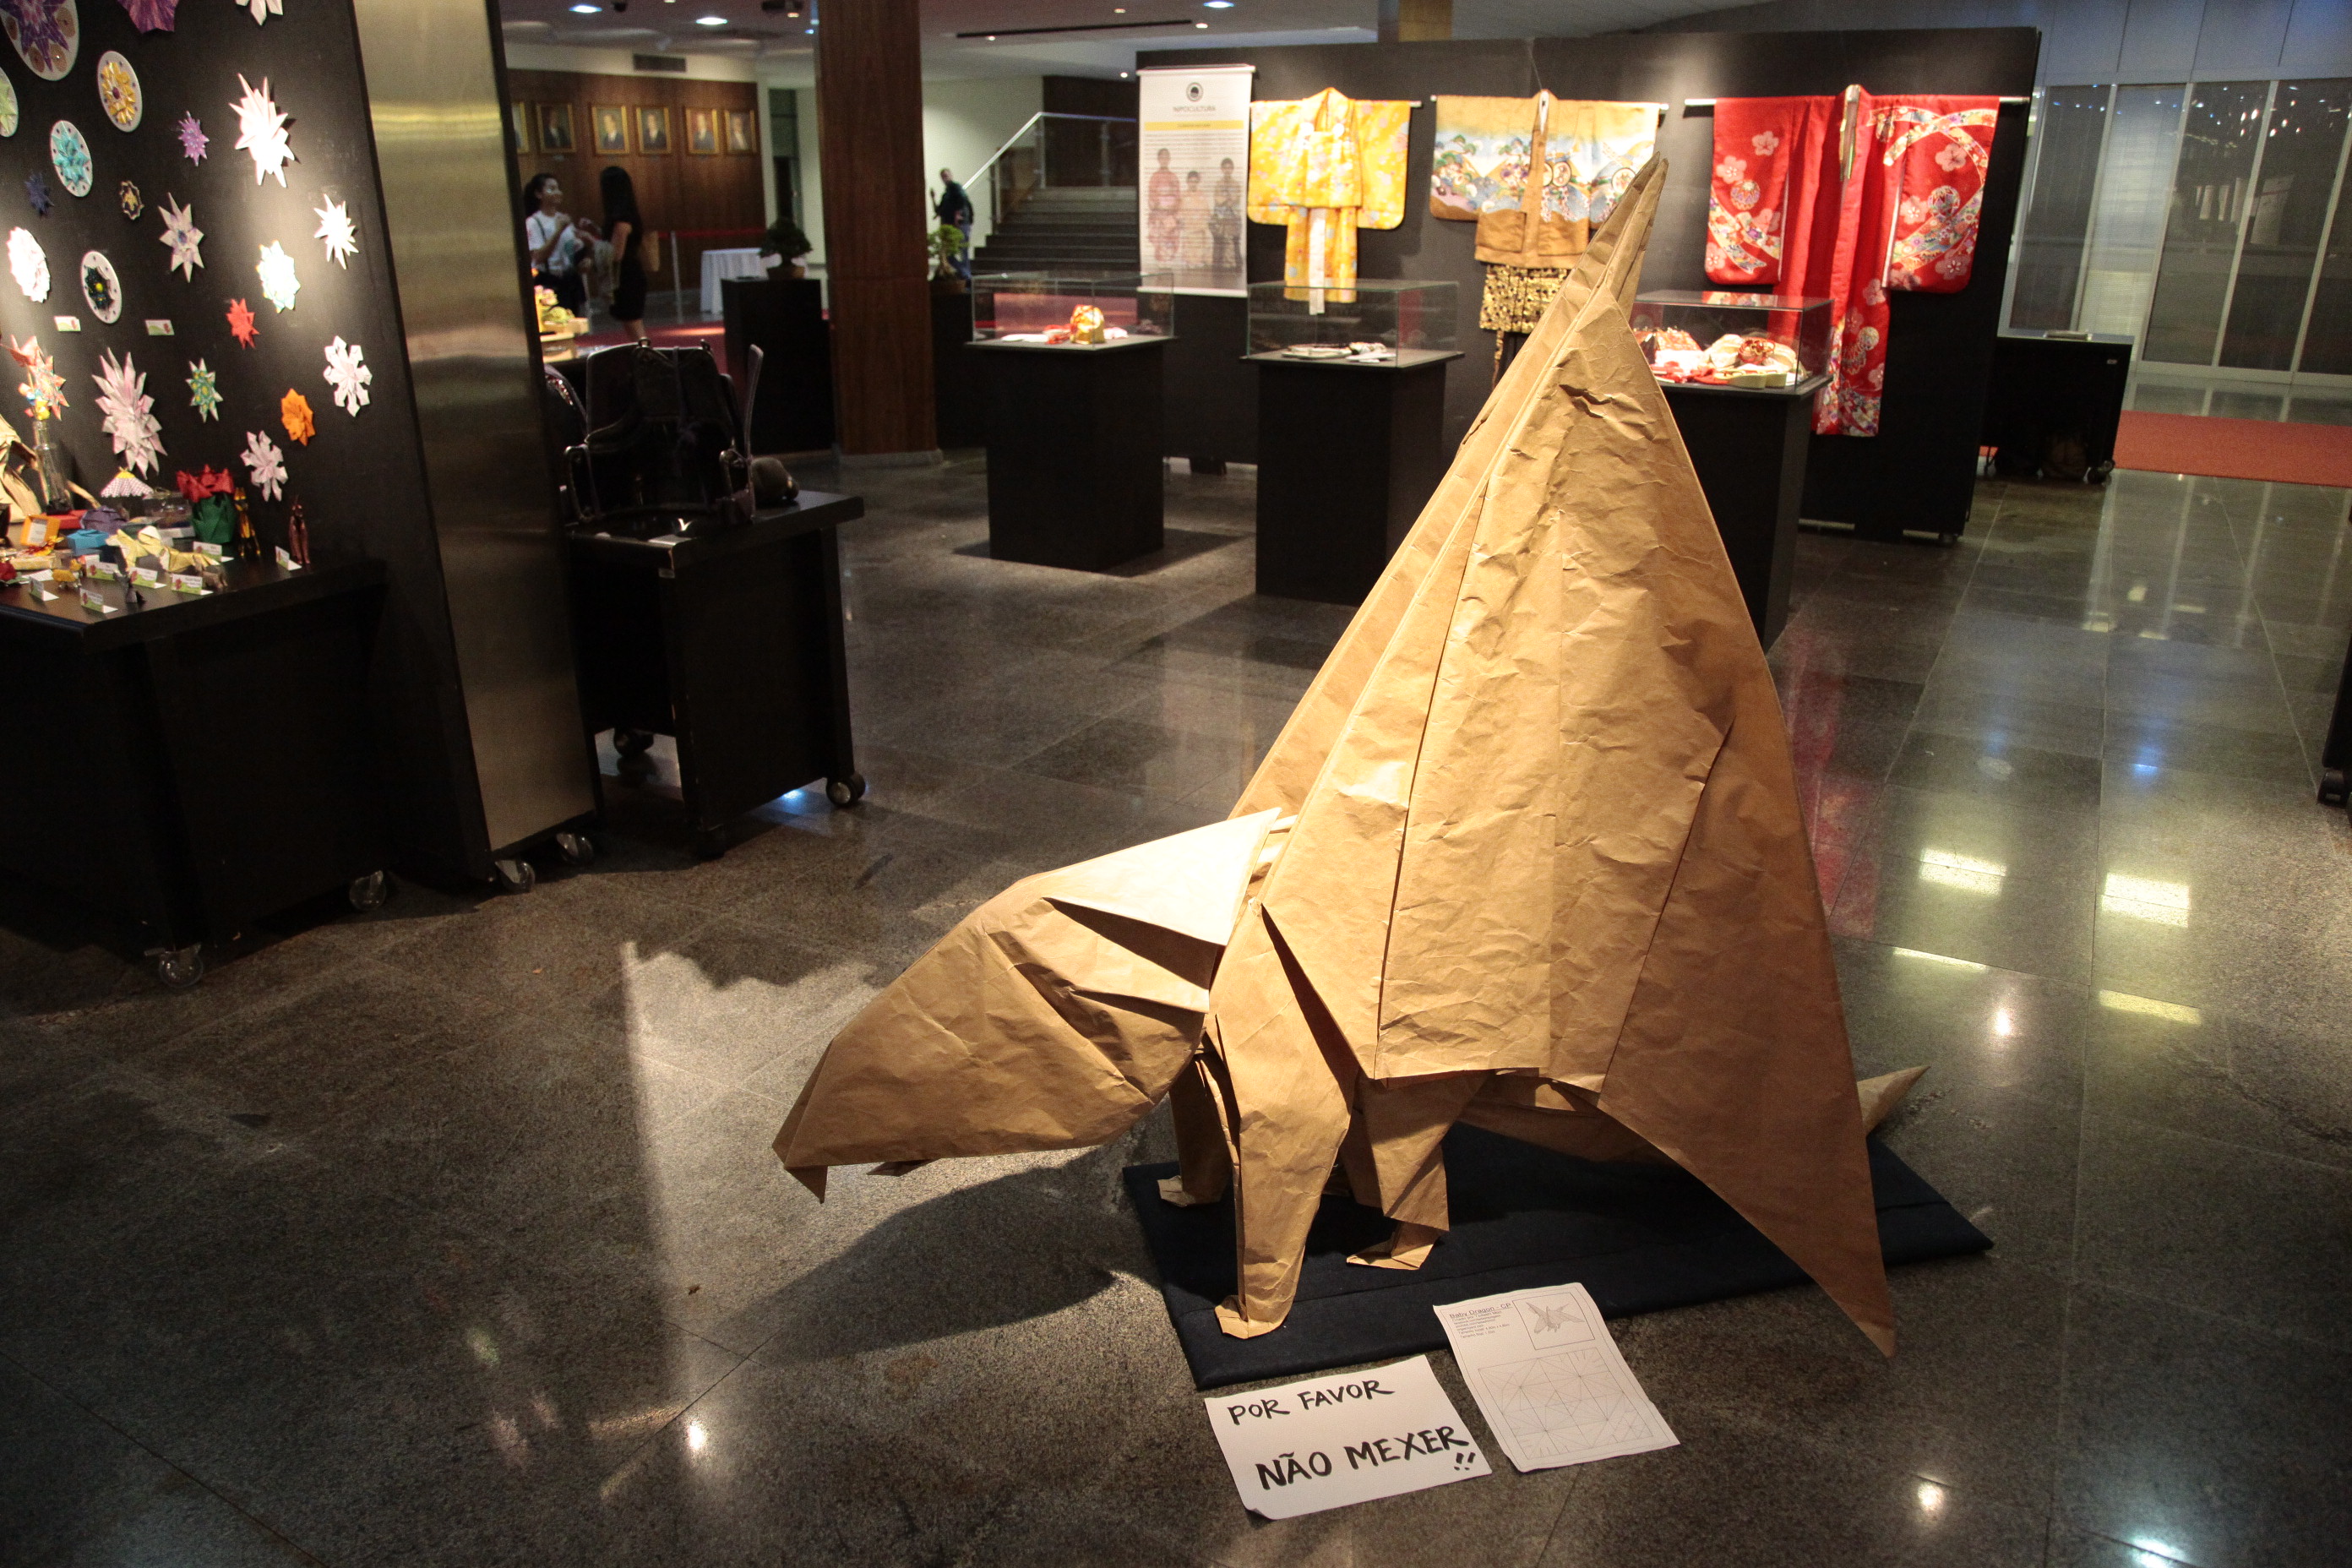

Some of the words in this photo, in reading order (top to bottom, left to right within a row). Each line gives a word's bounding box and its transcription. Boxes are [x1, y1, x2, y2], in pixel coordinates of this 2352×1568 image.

[1469, 1306, 1495, 1315] Dragon
[1228, 1399, 1291, 1425] POR
[1298, 1379, 1396, 1410] FAVOR
[1255, 1451, 1332, 1491] NÃO
[1343, 1425, 1470, 1470] MEXER
